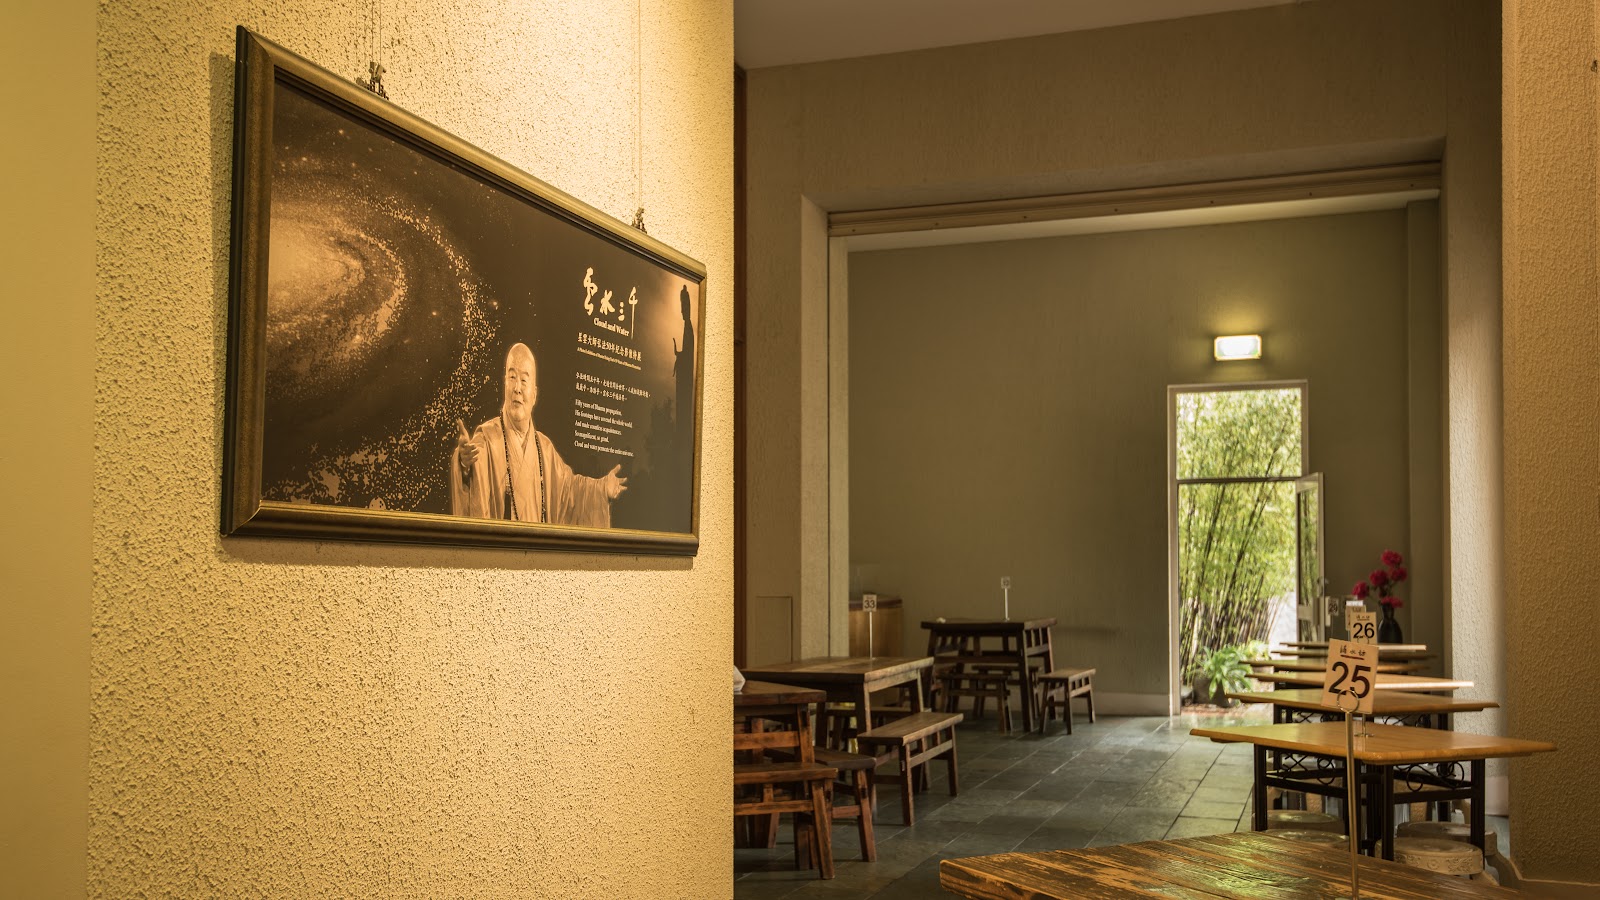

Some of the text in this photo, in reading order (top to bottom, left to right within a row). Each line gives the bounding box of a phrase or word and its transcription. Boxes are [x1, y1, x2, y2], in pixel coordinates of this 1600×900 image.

[593, 317, 630, 336] Cloud and Water
[574, 440, 583, 448] Cloud
[864, 599, 875, 609] 33
[1353, 622, 1375, 638] 26
[1328, 661, 1371, 698] 25
